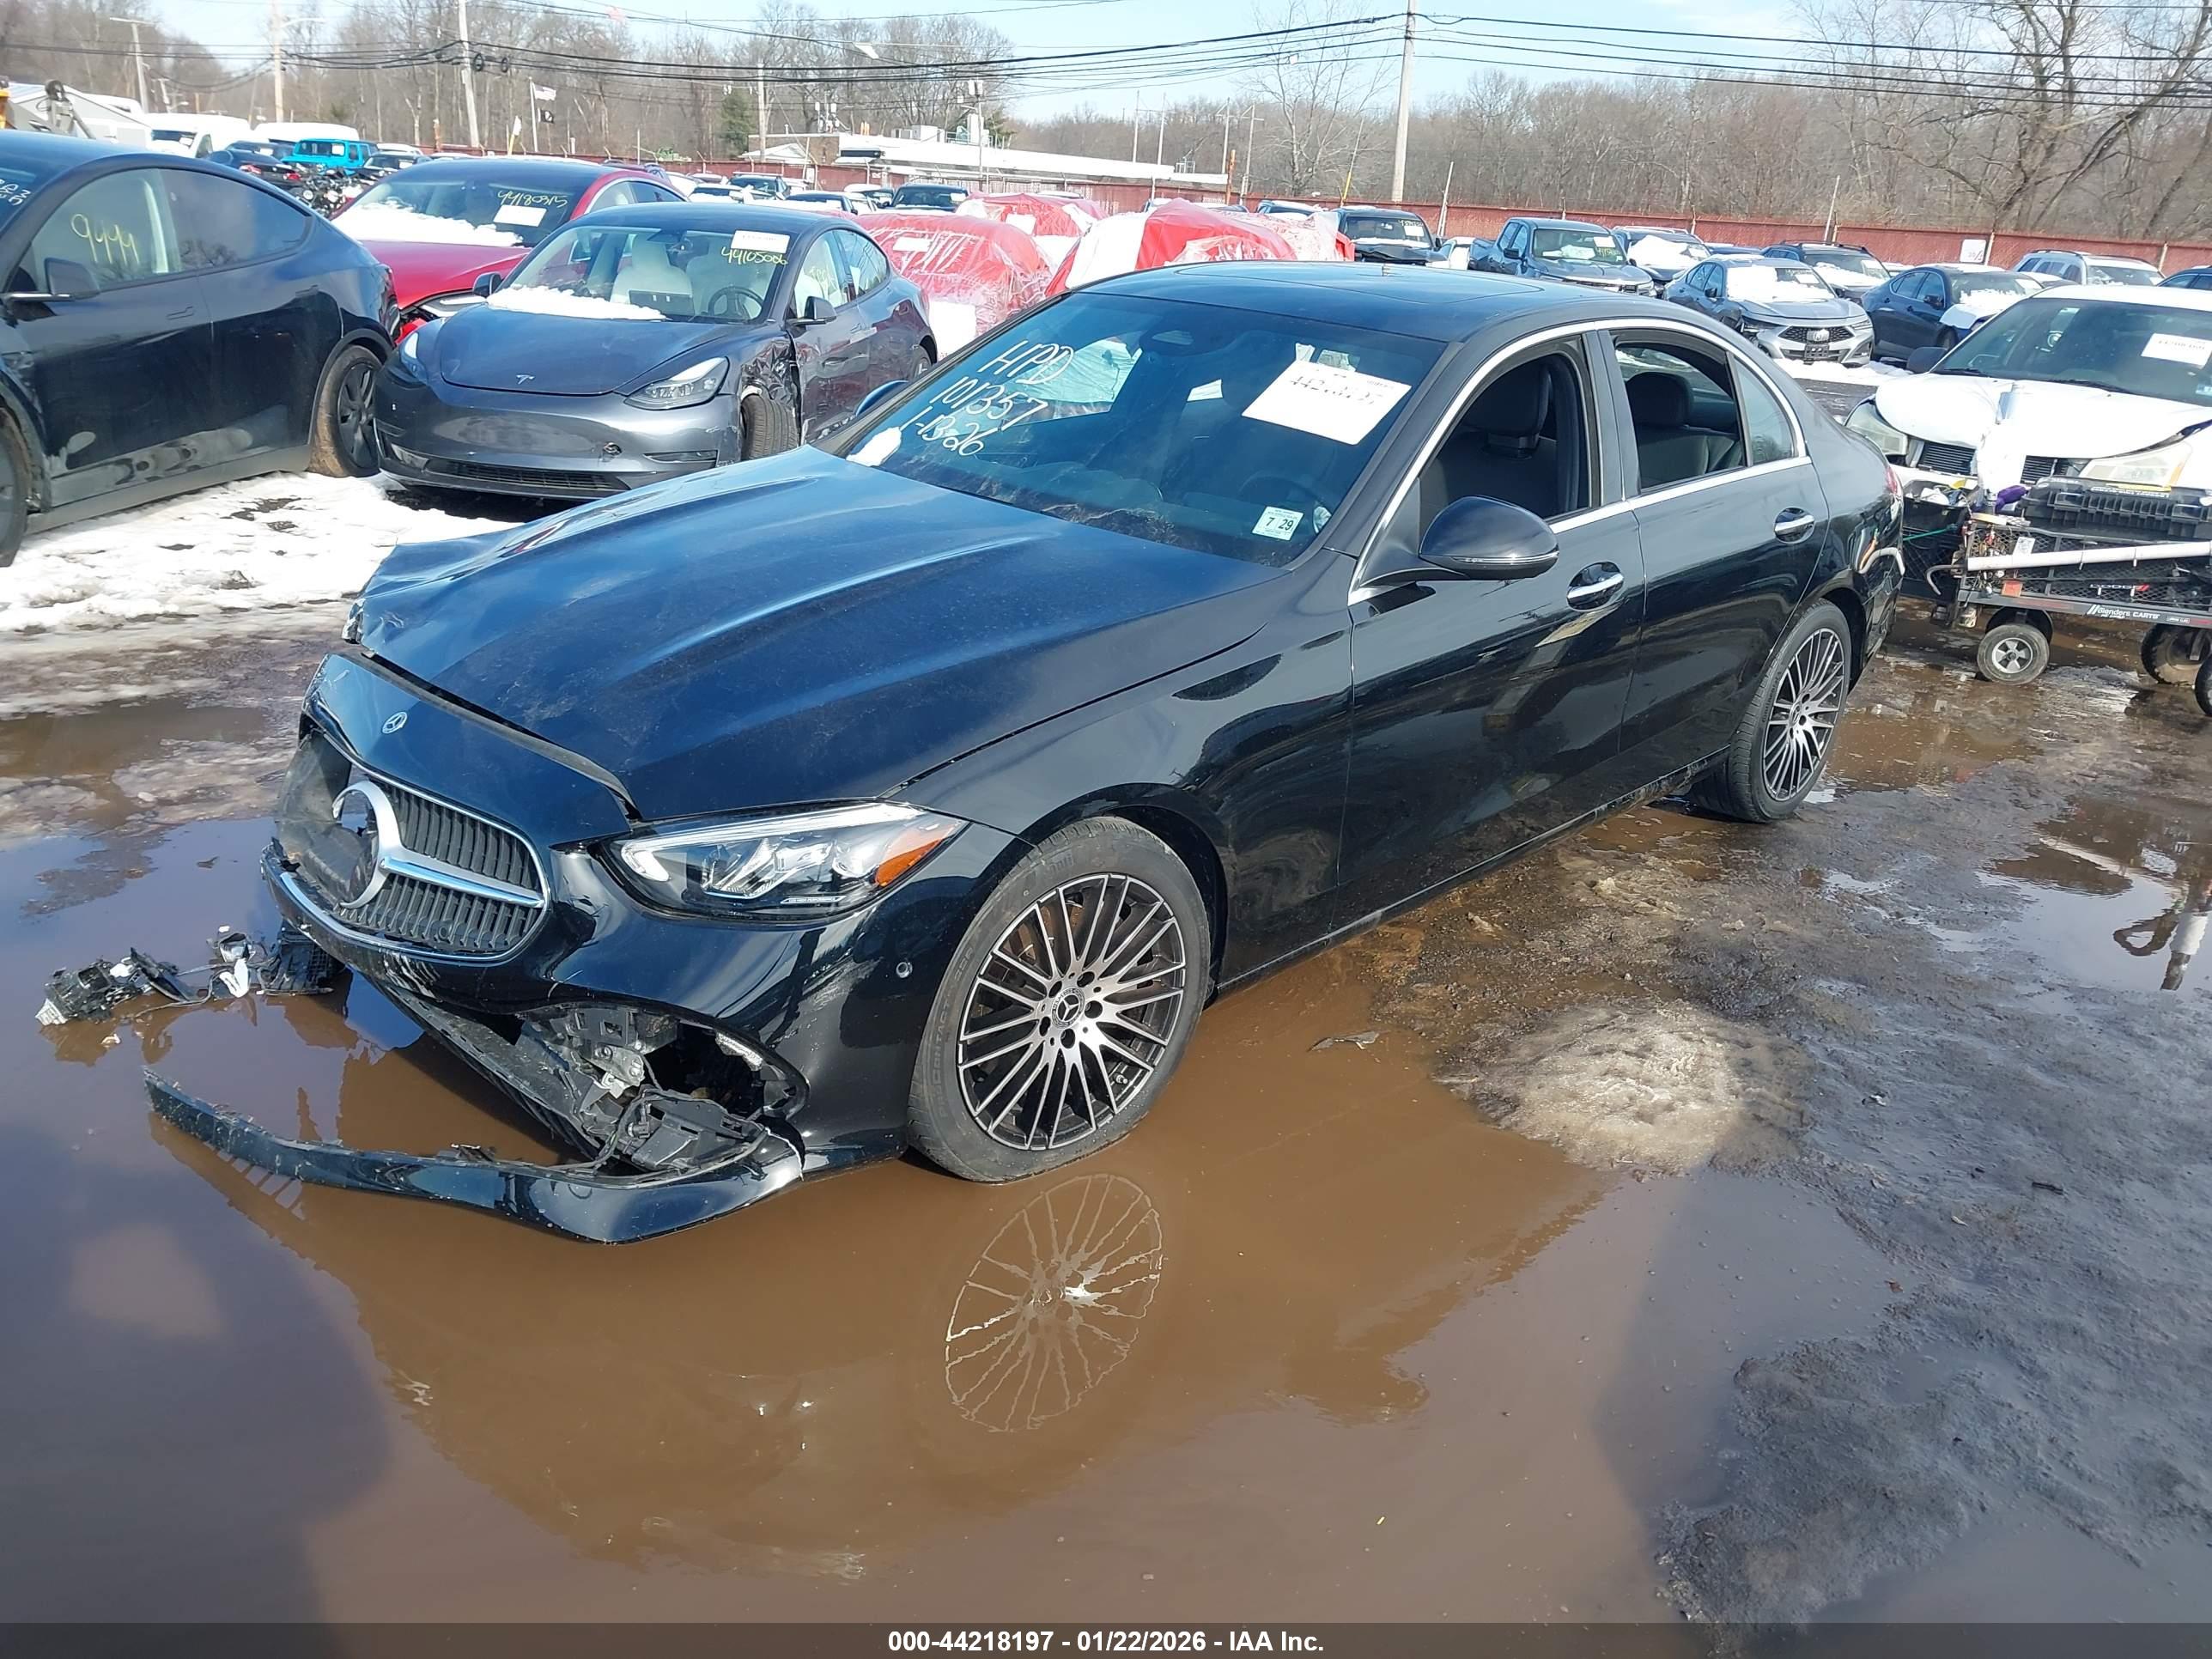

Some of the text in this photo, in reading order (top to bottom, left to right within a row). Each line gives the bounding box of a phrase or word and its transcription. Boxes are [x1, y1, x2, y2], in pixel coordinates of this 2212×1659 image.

[720, 246, 789, 265] 44105006
[976, 339, 1074, 385] HPD
[929, 376, 1048, 431] 101357
[1266, 516, 1294, 532] 7 29
